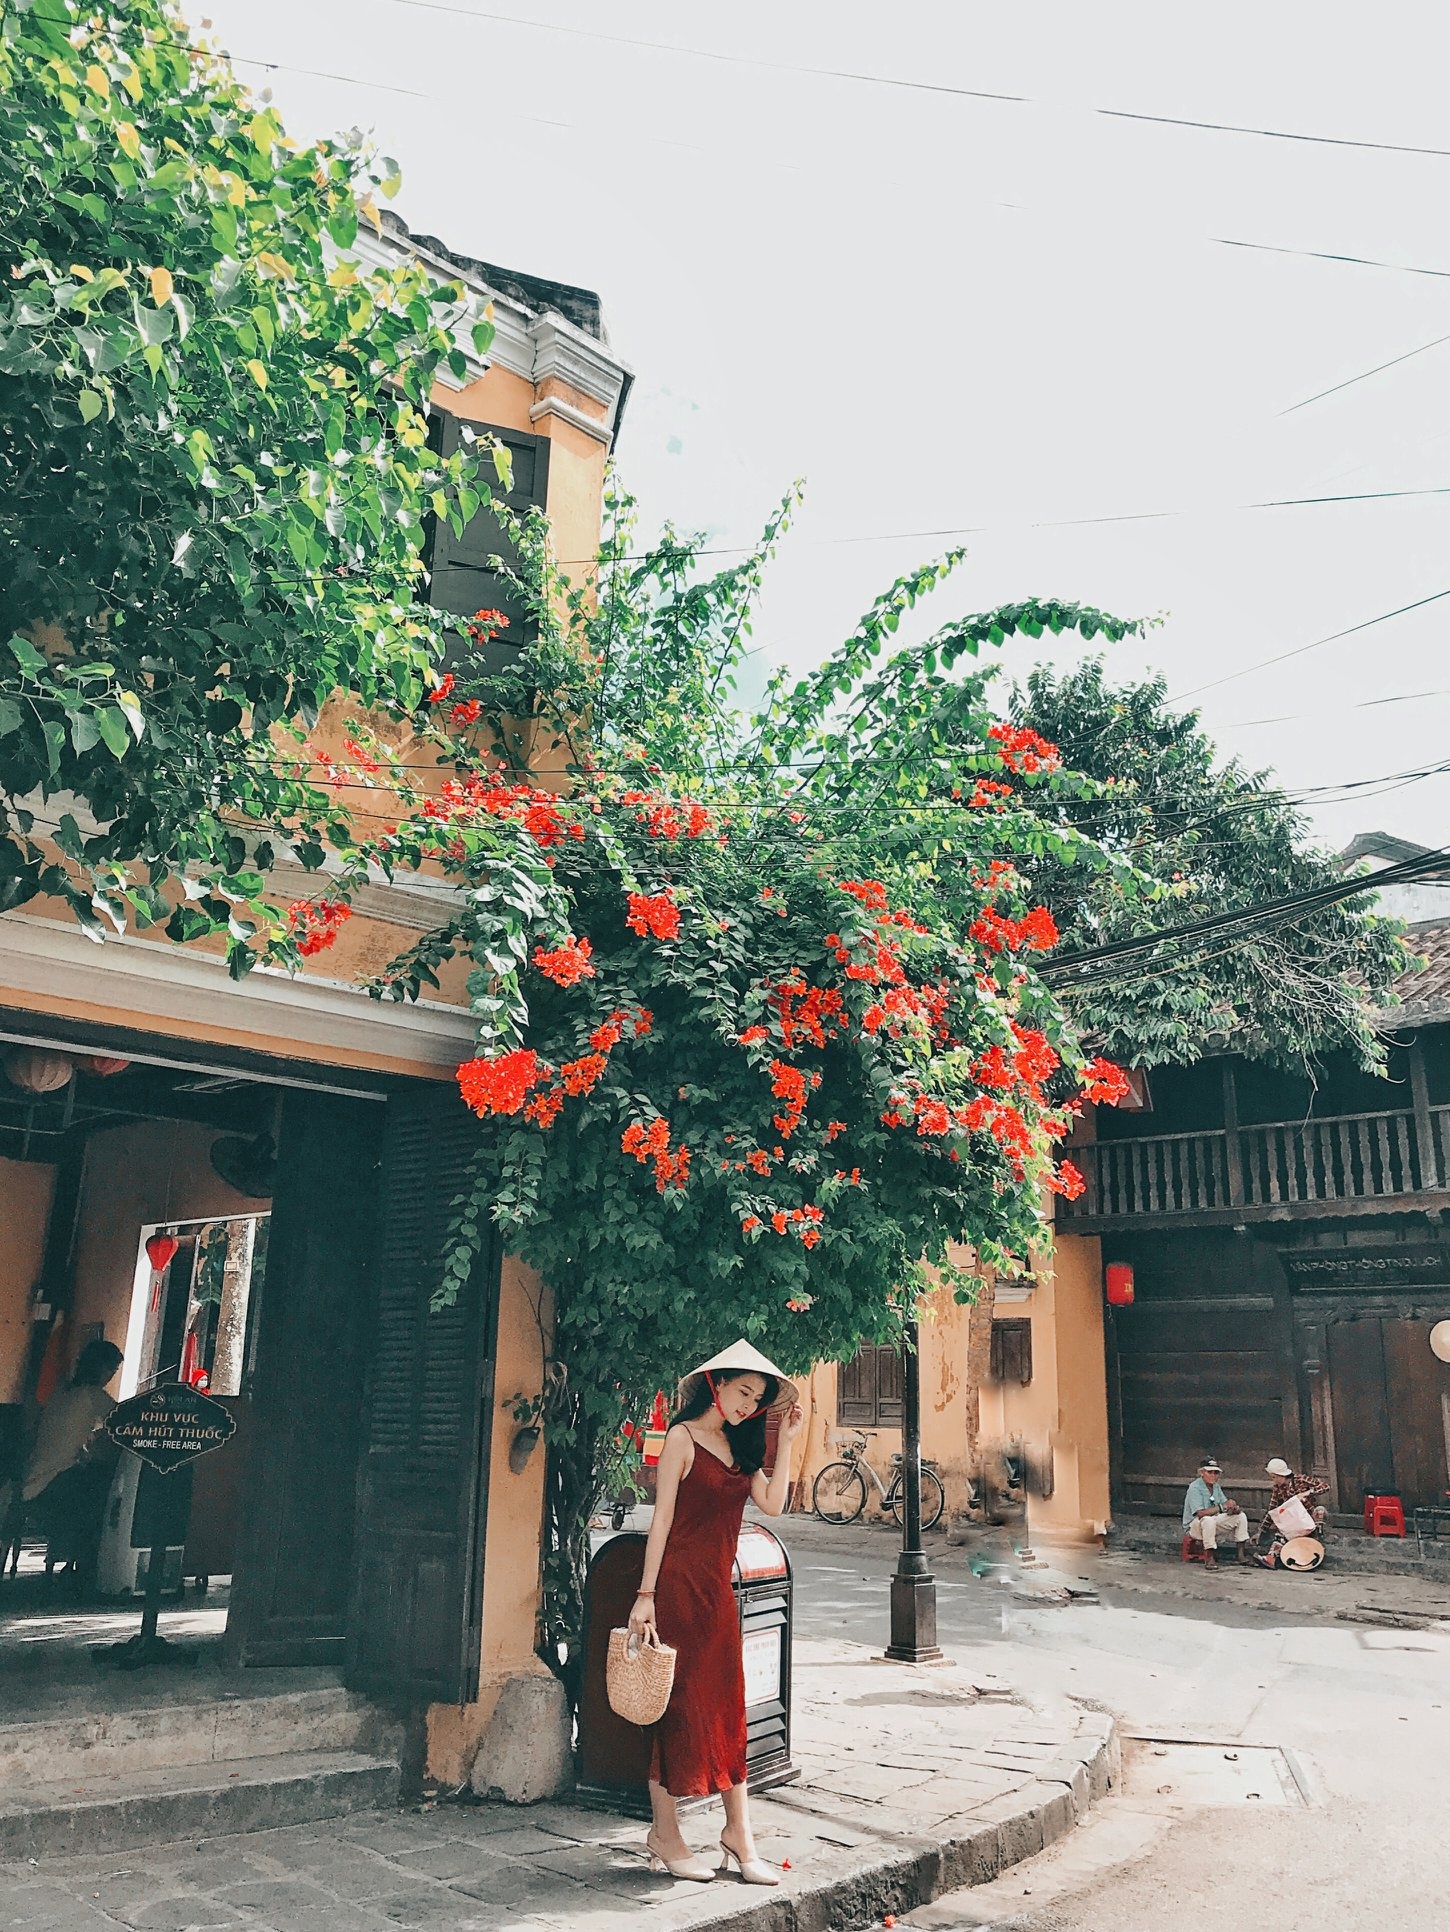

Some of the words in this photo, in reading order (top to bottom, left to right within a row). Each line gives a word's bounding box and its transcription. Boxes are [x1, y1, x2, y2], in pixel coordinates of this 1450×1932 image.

[140, 1412, 169, 1422] KHU
[148, 1424, 174, 1437] HÚT
[132, 1439, 158, 1449] SMOKE
[162, 1440, 181, 1450] FREE
[182, 1441, 202, 1451] AREA
